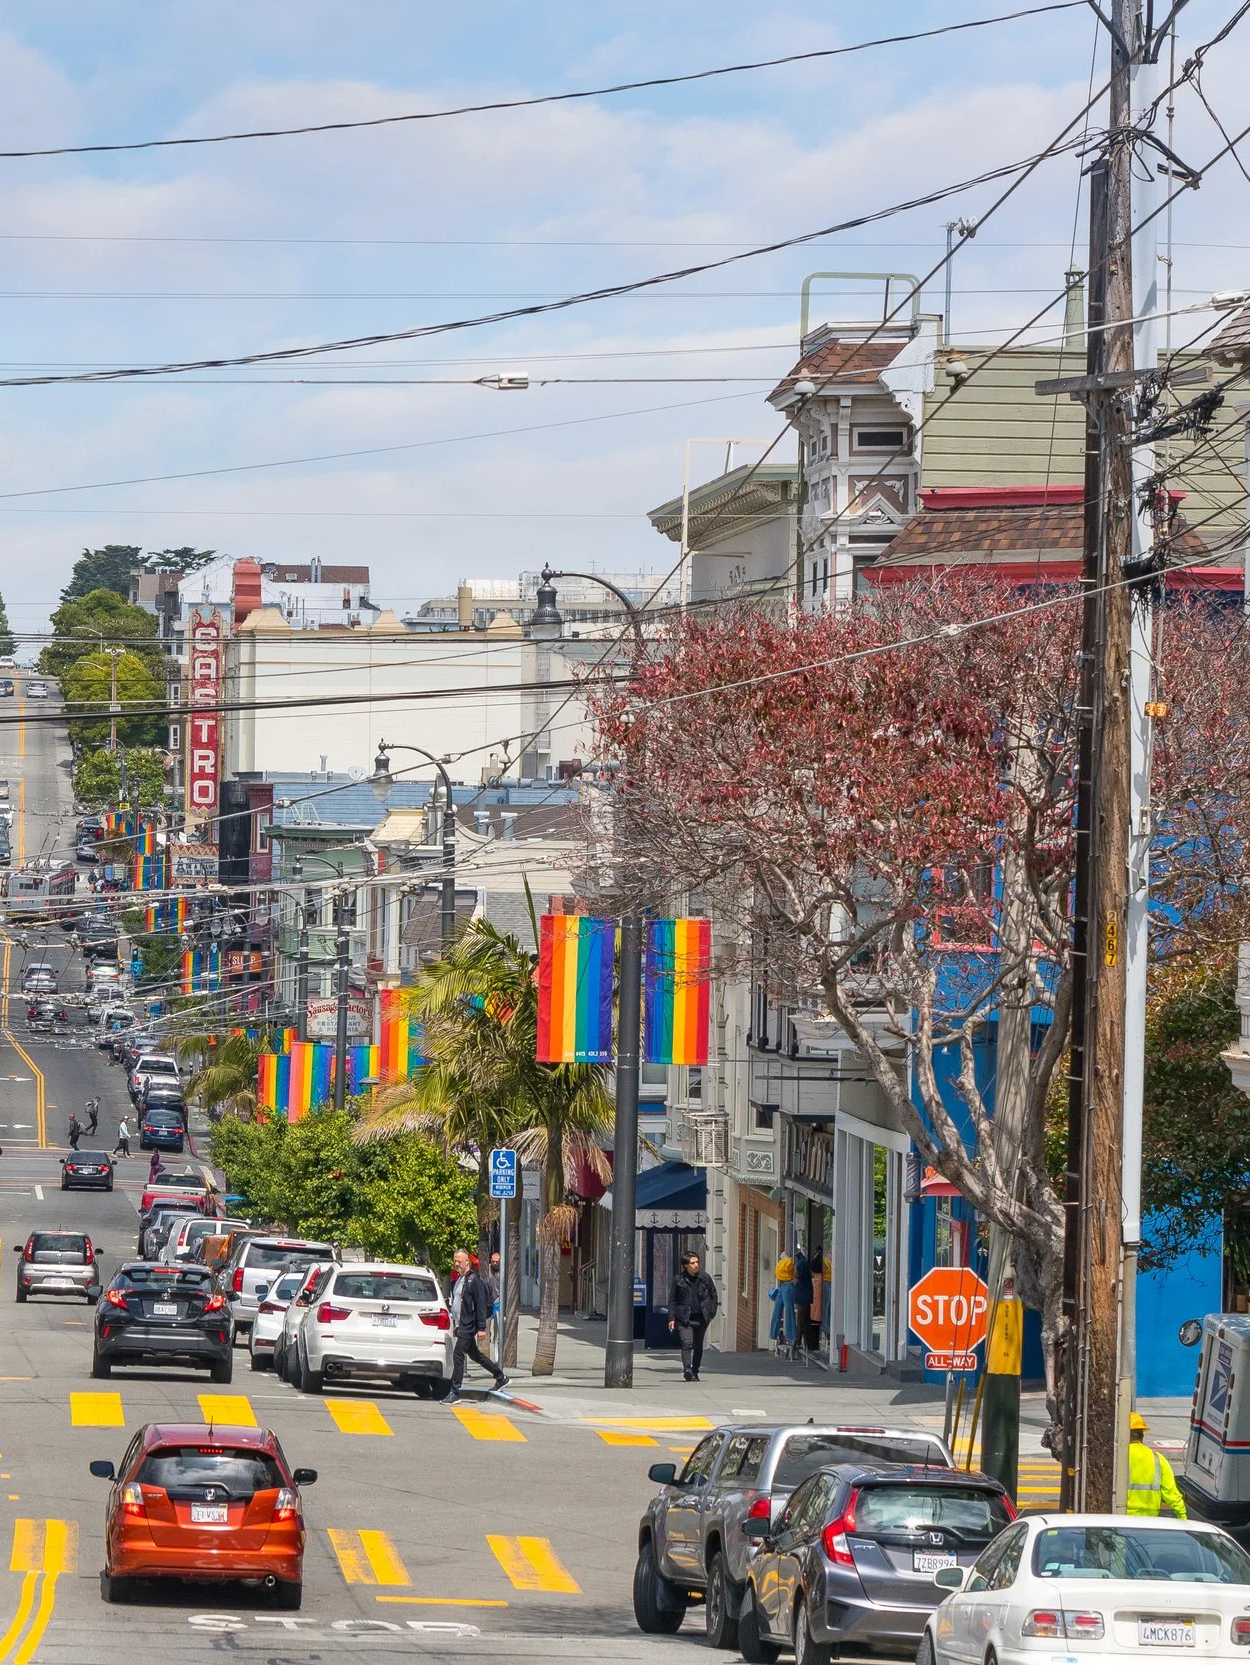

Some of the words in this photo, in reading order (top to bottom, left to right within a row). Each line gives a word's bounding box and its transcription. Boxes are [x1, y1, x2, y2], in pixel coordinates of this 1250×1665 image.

[193, 627, 218, 805] CASTRO
[1107, 911, 1115, 965] 2467
[306, 1003, 338, 1018] Sausag
[347, 1003, 374, 1018] actory
[493, 1168, 515, 1176] PARKING
[497, 1175, 510, 1183] ONLY
[916, 1295, 987, 1326] STOP
[928, 1356, 974, 1367] ALL-WAY
[916, 1557, 955, 1571] 7ZBR996
[1143, 1627, 1192, 1641] 4MCK876
